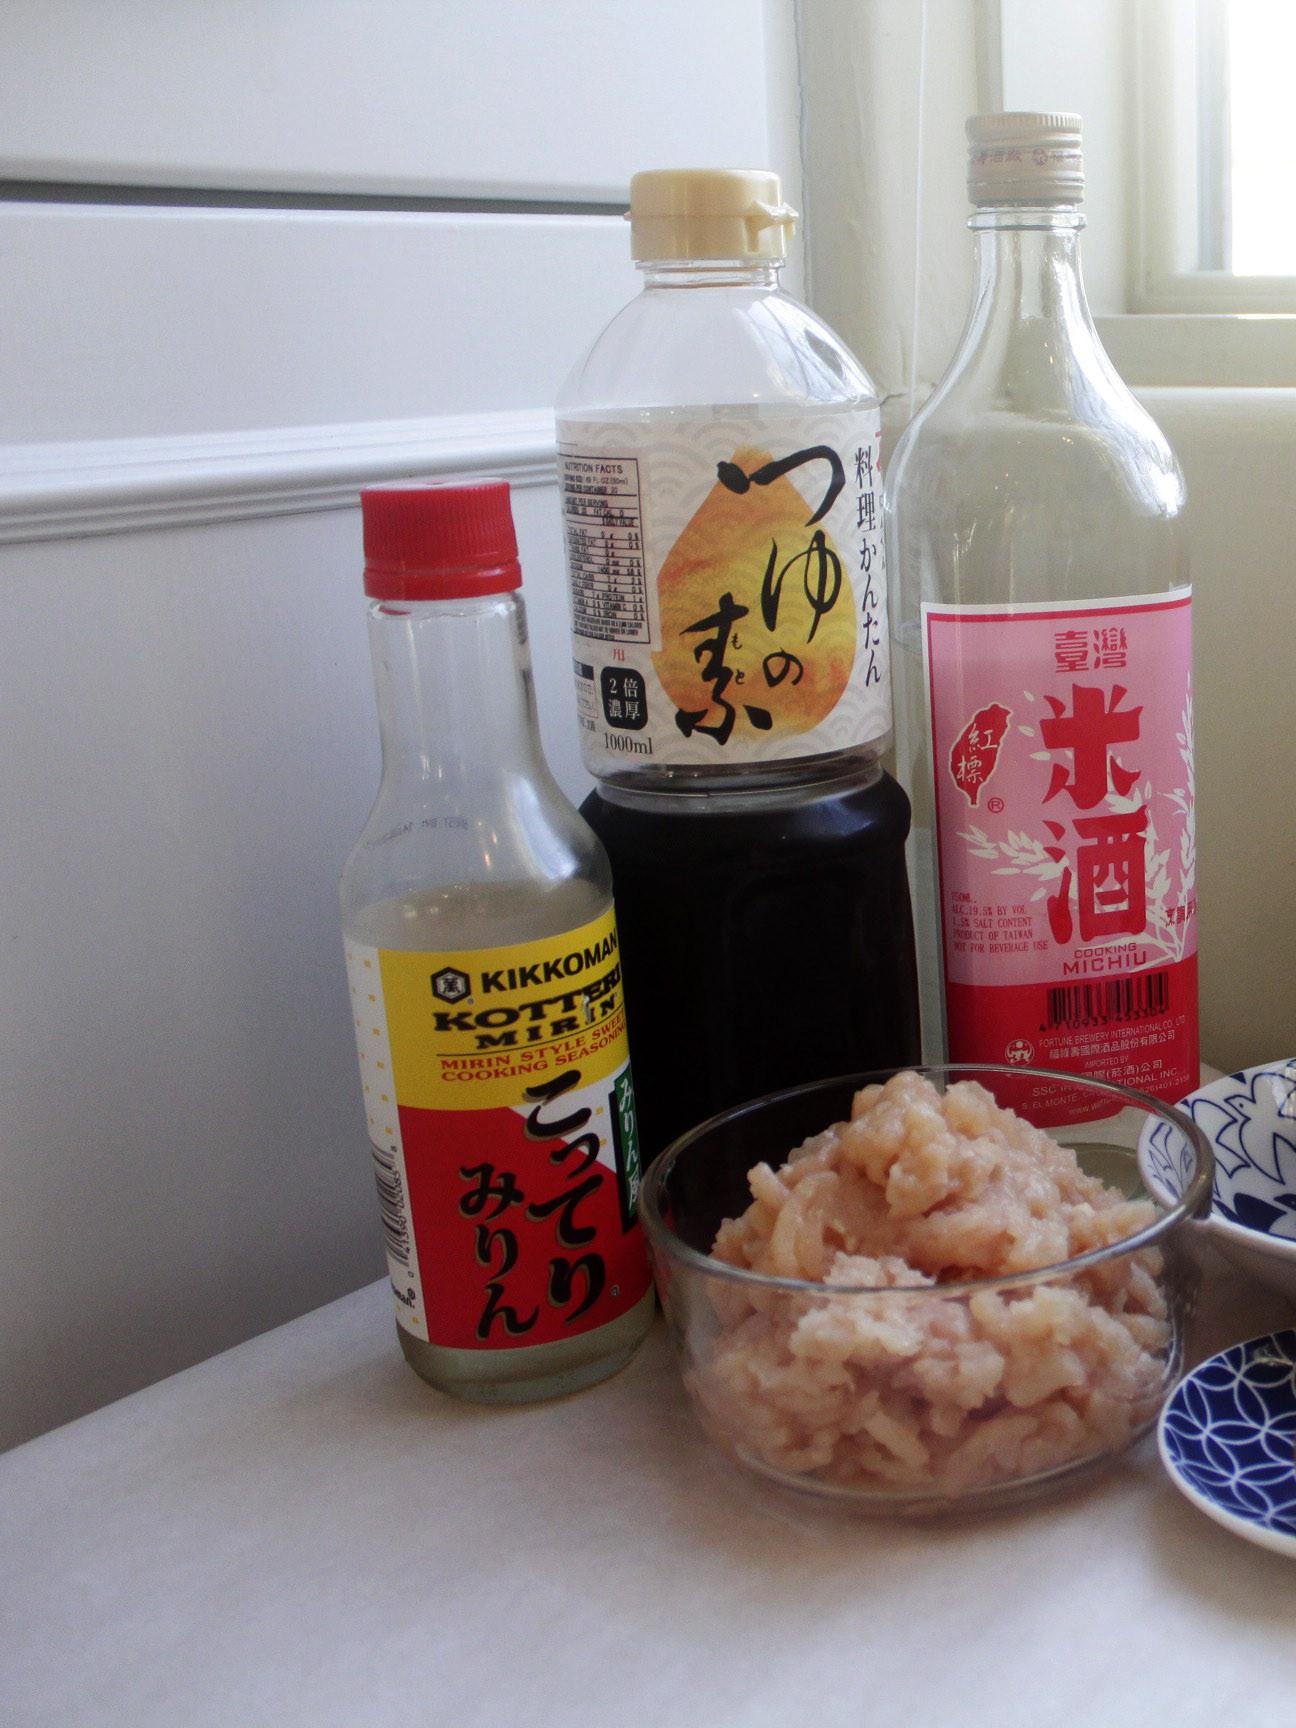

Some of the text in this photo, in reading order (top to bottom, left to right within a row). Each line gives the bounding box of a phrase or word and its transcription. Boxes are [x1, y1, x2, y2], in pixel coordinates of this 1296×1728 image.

[595, 464, 624, 475] FACTS
[716, 444, 846, 688] つゆの
[854, 445, 881, 687] 料理かんたん
[731, 634, 745, 686] もと
[1053, 627, 1129, 674] 臺灣
[608, 677, 639, 699] 2倍
[604, 732, 654, 755] 1000ml
[956, 722, 1000, 785] 紅標
[1039, 683, 1148, 945] 米酒
[974, 918, 993, 929] SALT
[997, 917, 1032, 929] CONTENT
[988, 931, 999, 941] OF
[1003, 929, 1033, 940] TAIWAN
[997, 905, 1007, 916] BY
[481, 928, 618, 993] KIKKOMAN
[970, 943, 985, 953] FOR
[989, 942, 1029, 953] BEVERAGE
[1033, 940, 1048, 952] USE
[1063, 951, 1147, 976] MICHIU
[1074, 942, 1137, 959] COOKING
[432, 961, 622, 1031] KOTTERI
[441, 1008, 625, 1070] MIRIN STYLE SWEET
[475, 994, 616, 1050] MIRIN
[1039, 1036, 1074, 1048] FORTUNE
[1075, 1032, 1109, 1045] BREWERY
[1110, 1023, 1163, 1040] INTERNATIONAL
[441, 1021, 626, 1082] COOKING SEASONING
[1120, 1056, 1130, 1065] BY
[523, 1069, 606, 1325] こってり
[459, 1162, 540, 1340] みりん
